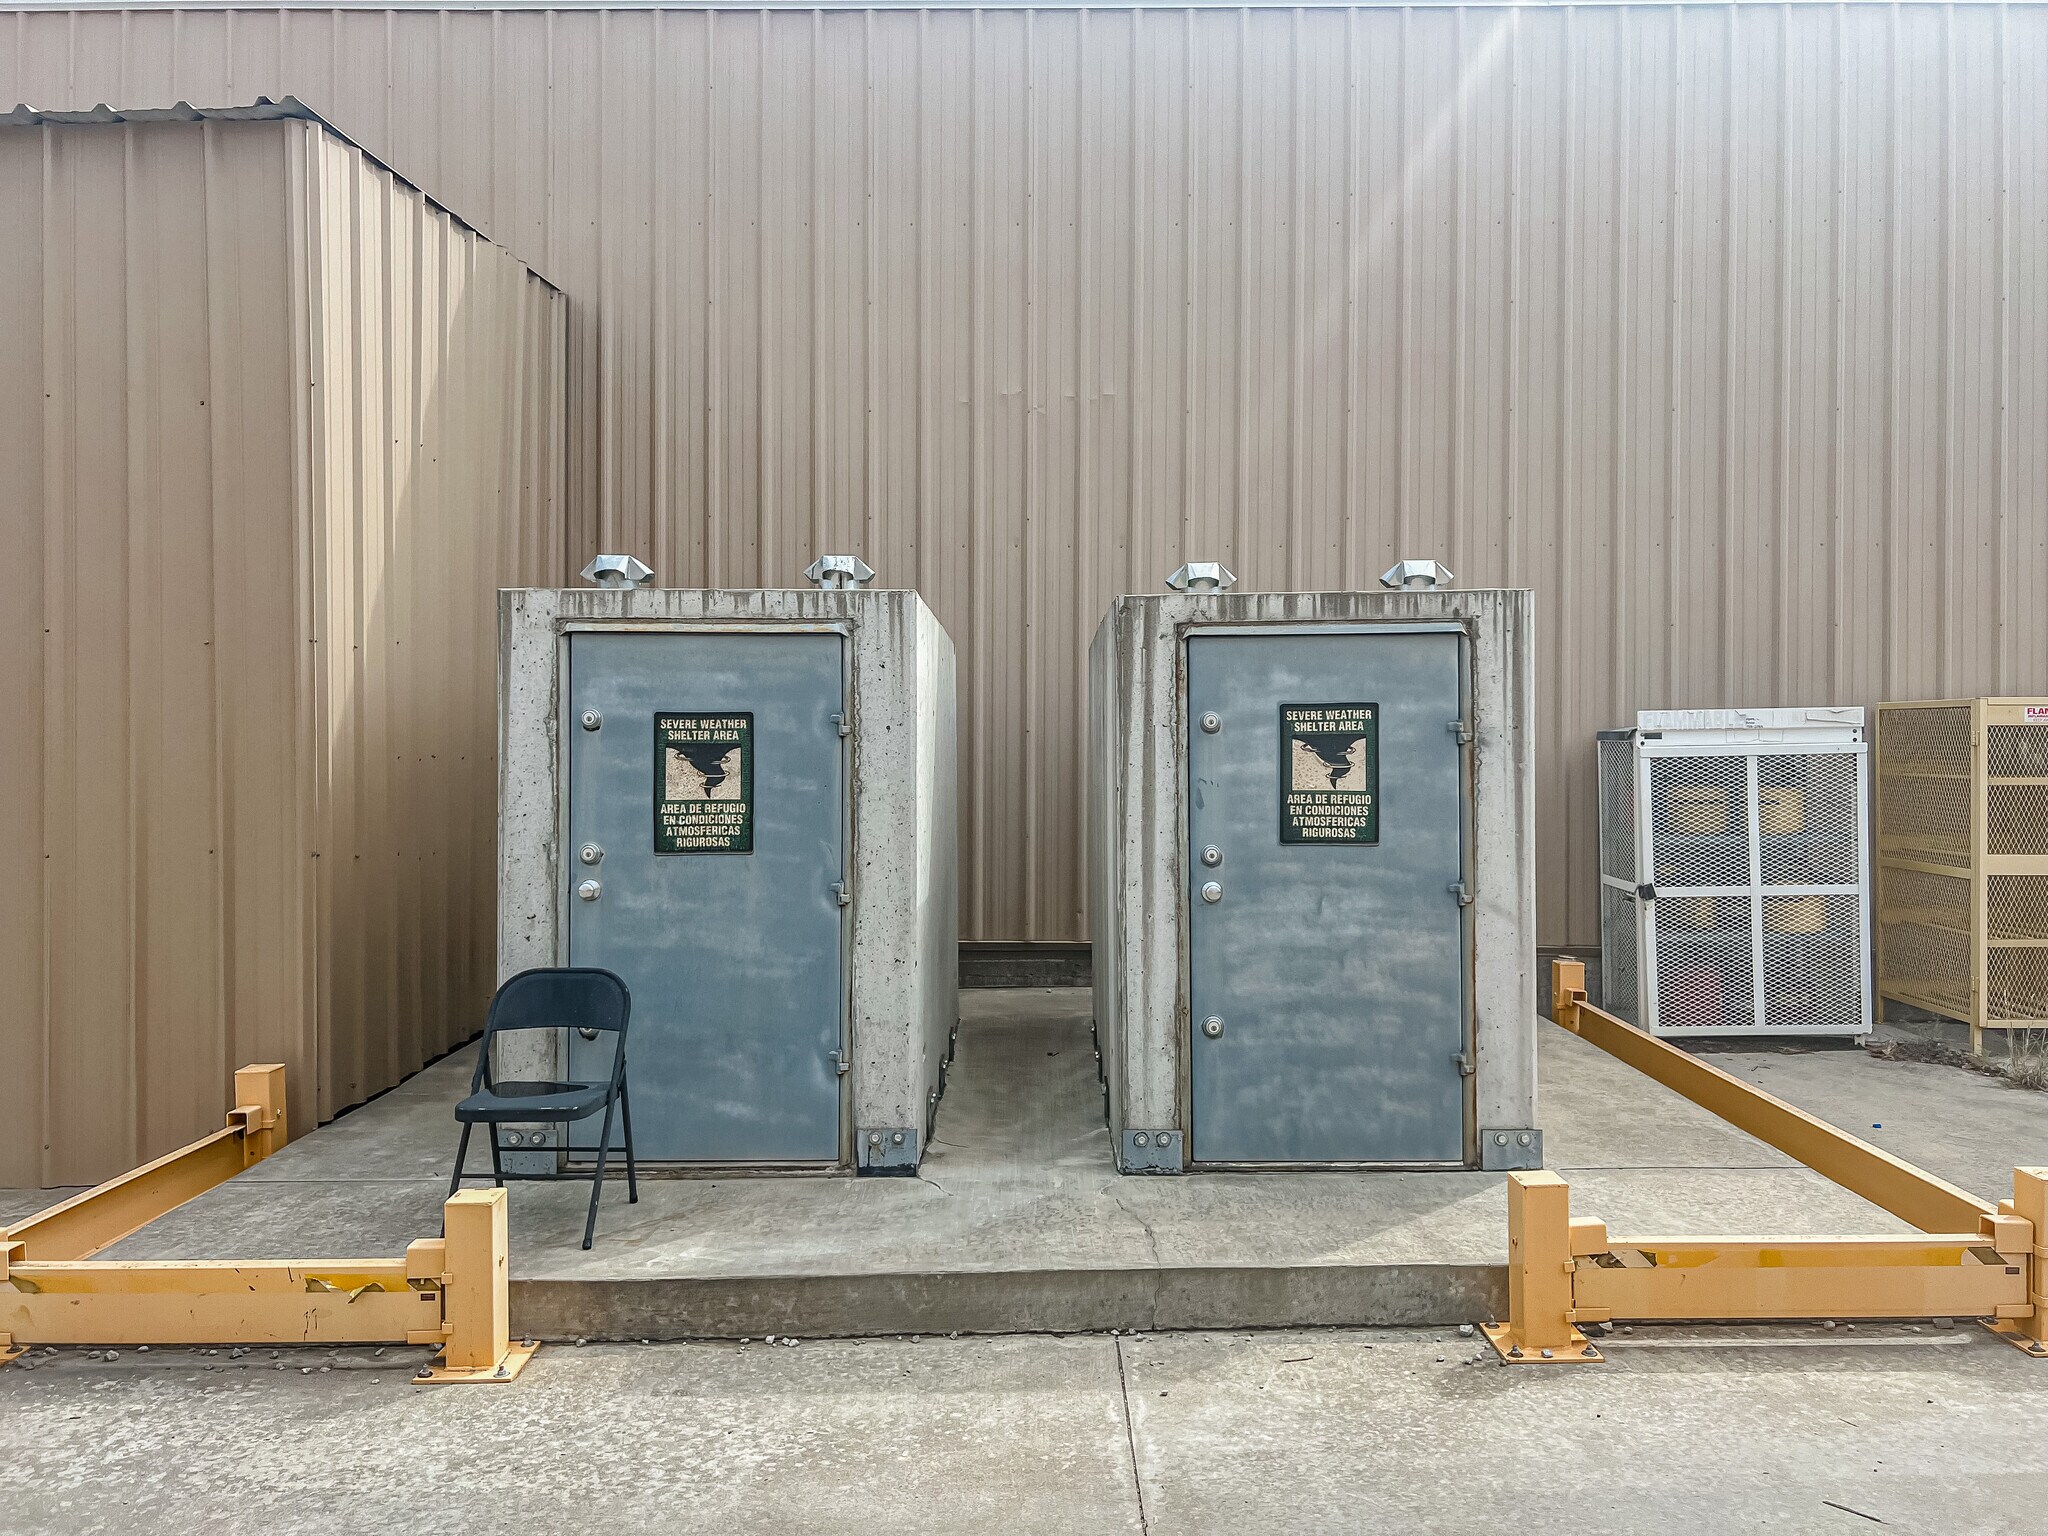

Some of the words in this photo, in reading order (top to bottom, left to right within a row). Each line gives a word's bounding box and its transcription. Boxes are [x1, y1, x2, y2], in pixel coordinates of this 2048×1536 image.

[1286, 711, 1322, 721] SEVERE
[1325, 710, 1372, 720] WEATHER
[660, 719, 697, 729] SEVERE
[700, 719, 747, 729] WEATHER
[1294, 722, 1336, 732] SHELTER
[1339, 722, 1364, 731] AREA
[668, 731, 710, 740] SHELTER
[713, 731, 739, 740] AREA
[1287, 794, 1312, 804] AREA
[1316, 794, 1327, 804] DE
[1331, 795, 1371, 805] REFUGIO
[661, 804, 686, 814] AREA
[690, 804, 701, 813] DE
[705, 804, 746, 813] REFUGIO
[1290, 806, 1302, 815] EN
[1305, 805, 1369, 815] CONDICIONES
[664, 815, 675, 825] EN
[679, 815, 743, 824] CONDICIONES
[1292, 817, 1366, 827] ATMOSFERICAS
[666, 826, 740, 836] ATMOSFERICAS
[1302, 828, 1356, 838] RIGUROSAS
[676, 837, 730, 847] RIGUROSAS
